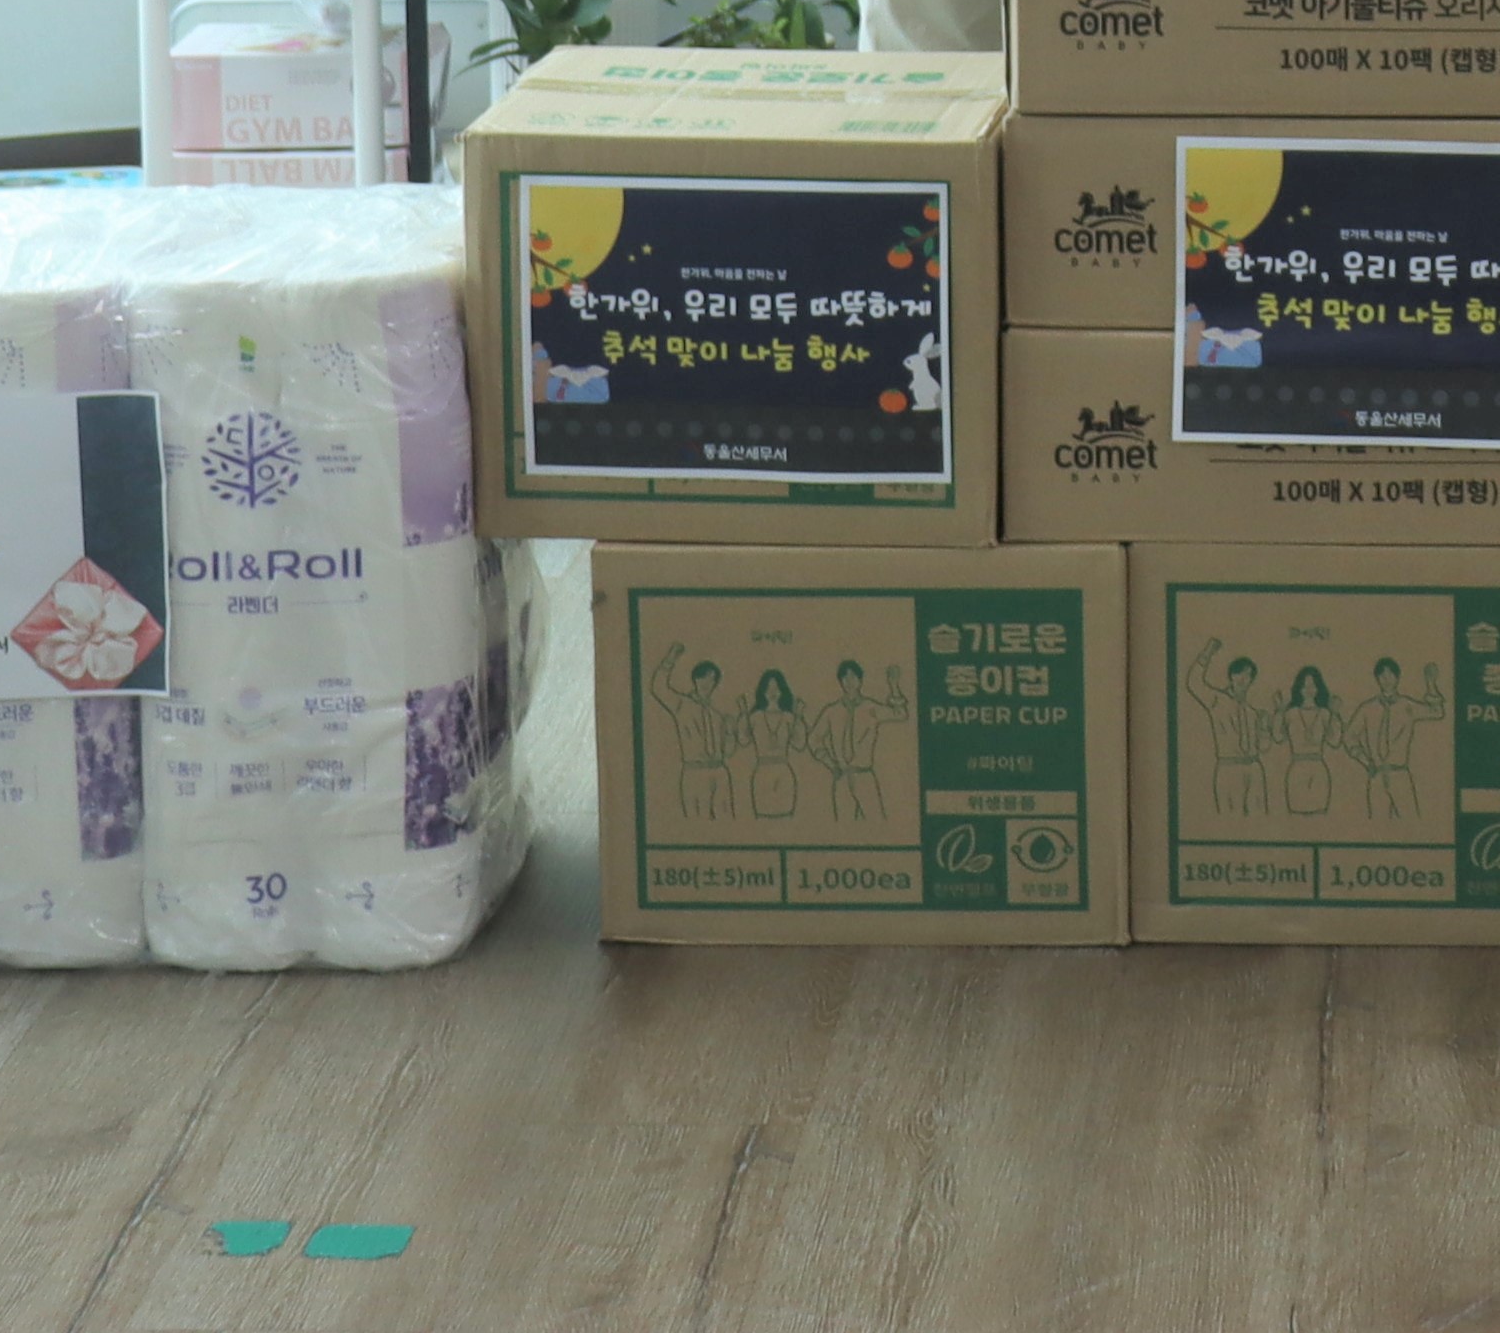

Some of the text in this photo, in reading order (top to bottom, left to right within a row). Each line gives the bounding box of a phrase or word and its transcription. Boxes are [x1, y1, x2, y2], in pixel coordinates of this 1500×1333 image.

[1060, 5, 1164, 37] comet
[1076, 40, 1147, 51] BABY
[1279, 48, 1349, 73] 100매
[1356, 49, 1372, 71] X
[1378, 48, 1434, 74] 10팩
[225, 94, 273, 112] DIET
[225, 116, 300, 144] GYM
[1053, 222, 1159, 256] comet
[1224, 247, 1330, 284] 한가위,
[1342, 251, 1397, 284] 우리
[1408, 254, 1459, 287] 모두
[568, 284, 933, 327] 한가위, 우리 모두 따뜻하게
[1257, 293, 1313, 329] 추석
[1323, 299, 1386, 331] 맞이
[1399, 300, 1454, 335] 나눔
[602, 330, 870, 372] 추석 맞이 나눔 행사
[1354, 410, 1442, 429] 동울산세무서
[702, 443, 788, 463] 동울산세무서
[1053, 438, 1159, 470] comet
[1272, 479, 1500, 508] 100매 X 10팩 (캡형)
[168, 547, 364, 582] oll&Roll
[227, 595, 279, 615] 라벤더
[927, 622, 1068, 656] 슬기로운
[944, 664, 1050, 697] 종이컵
[303, 696, 366, 715] 부드러운
[930, 704, 1068, 726] PAPER CUP
[245, 872, 288, 905] 30
[652, 866, 775, 890] 180(±5)ml
[797, 866, 912, 892] 1,000ea
[1183, 862, 1308, 887] 180(±5)ml
[1329, 863, 1445, 891] 1,000ea
